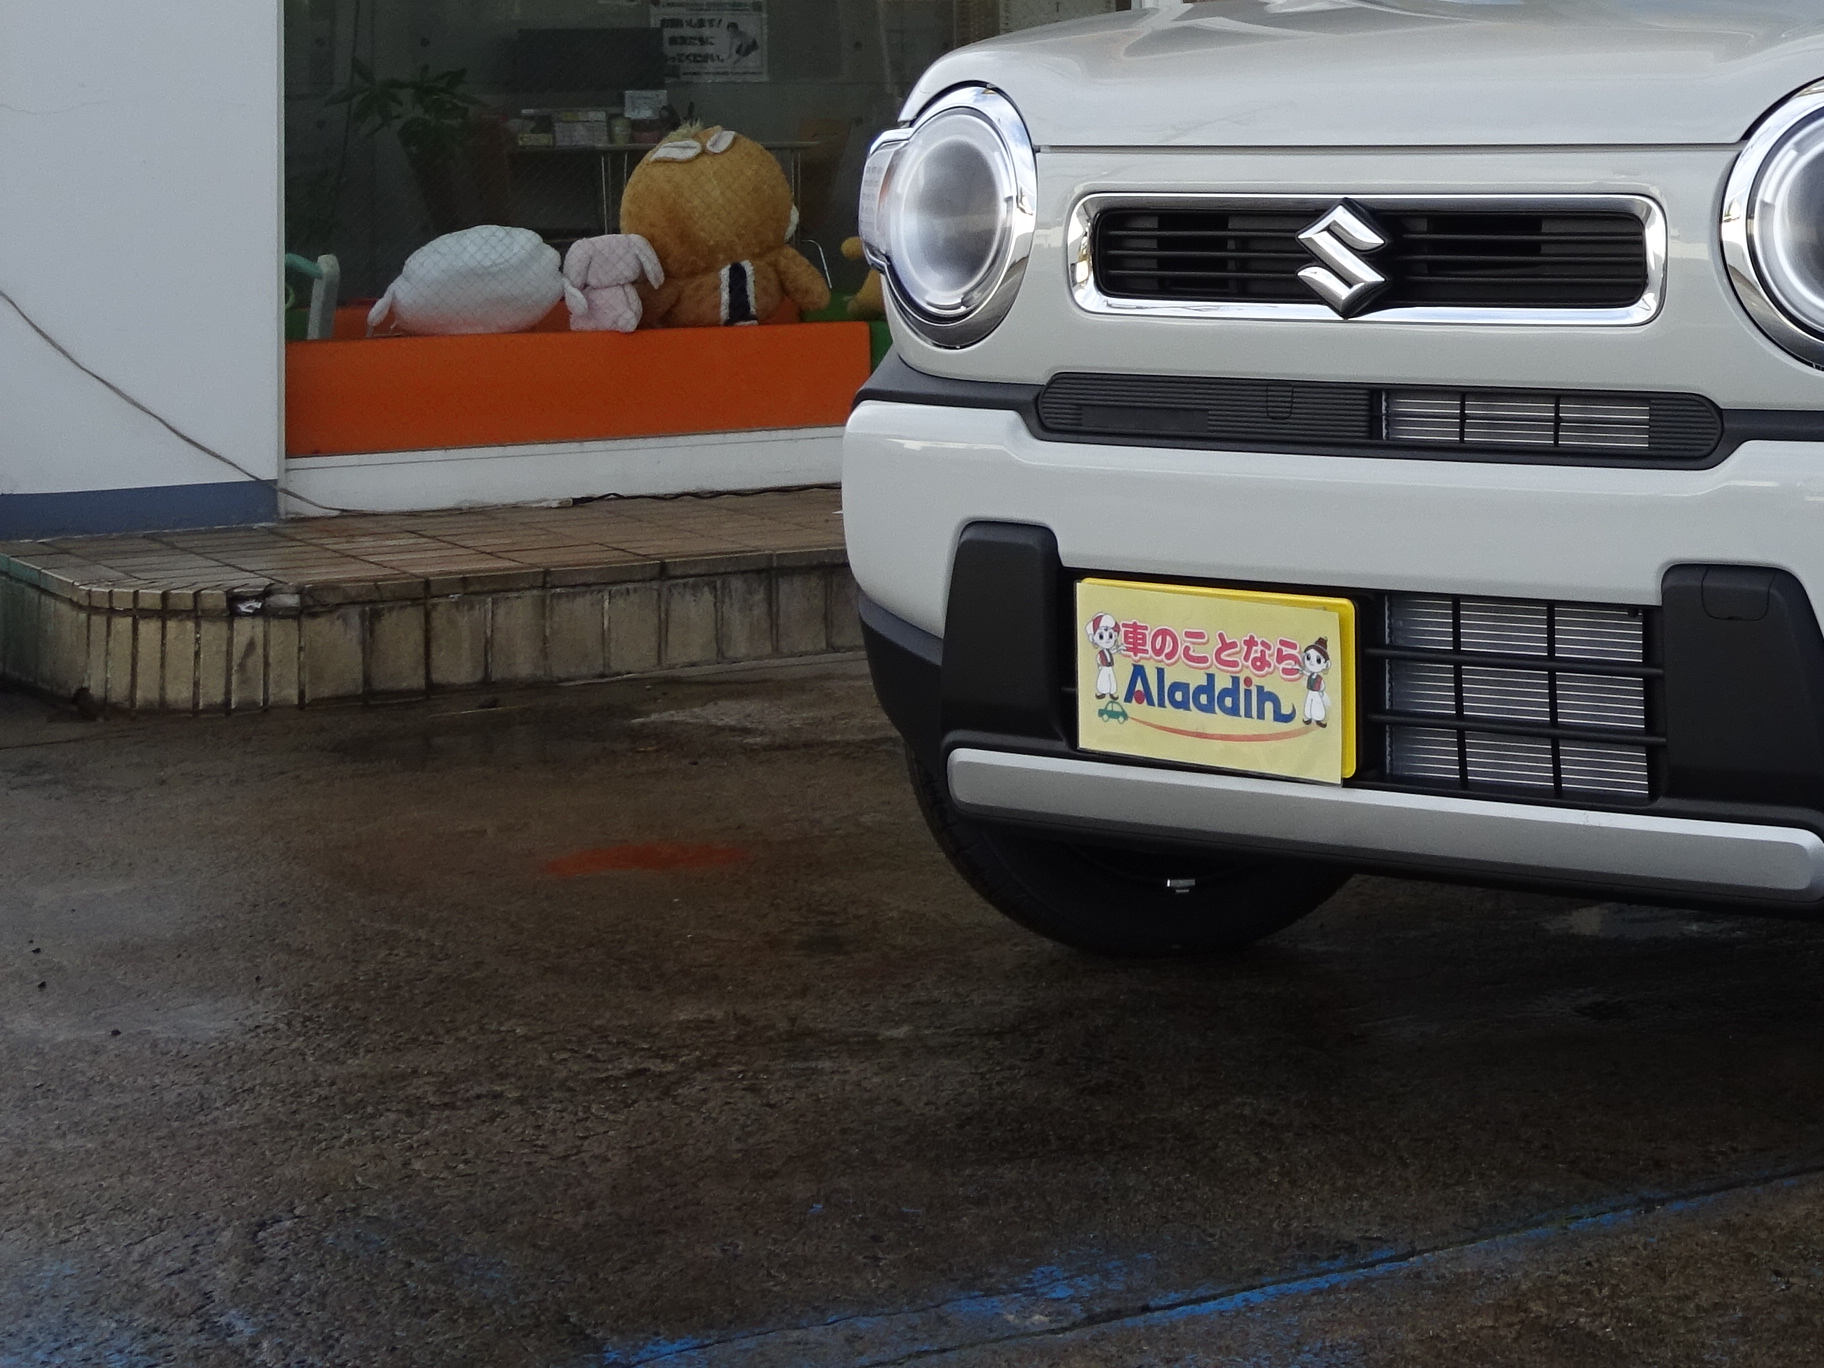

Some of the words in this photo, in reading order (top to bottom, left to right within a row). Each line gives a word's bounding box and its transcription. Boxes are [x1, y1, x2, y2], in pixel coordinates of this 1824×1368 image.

[1120, 620, 1304, 680] 車のことなら
[1123, 663, 1297, 724] Aladdin
